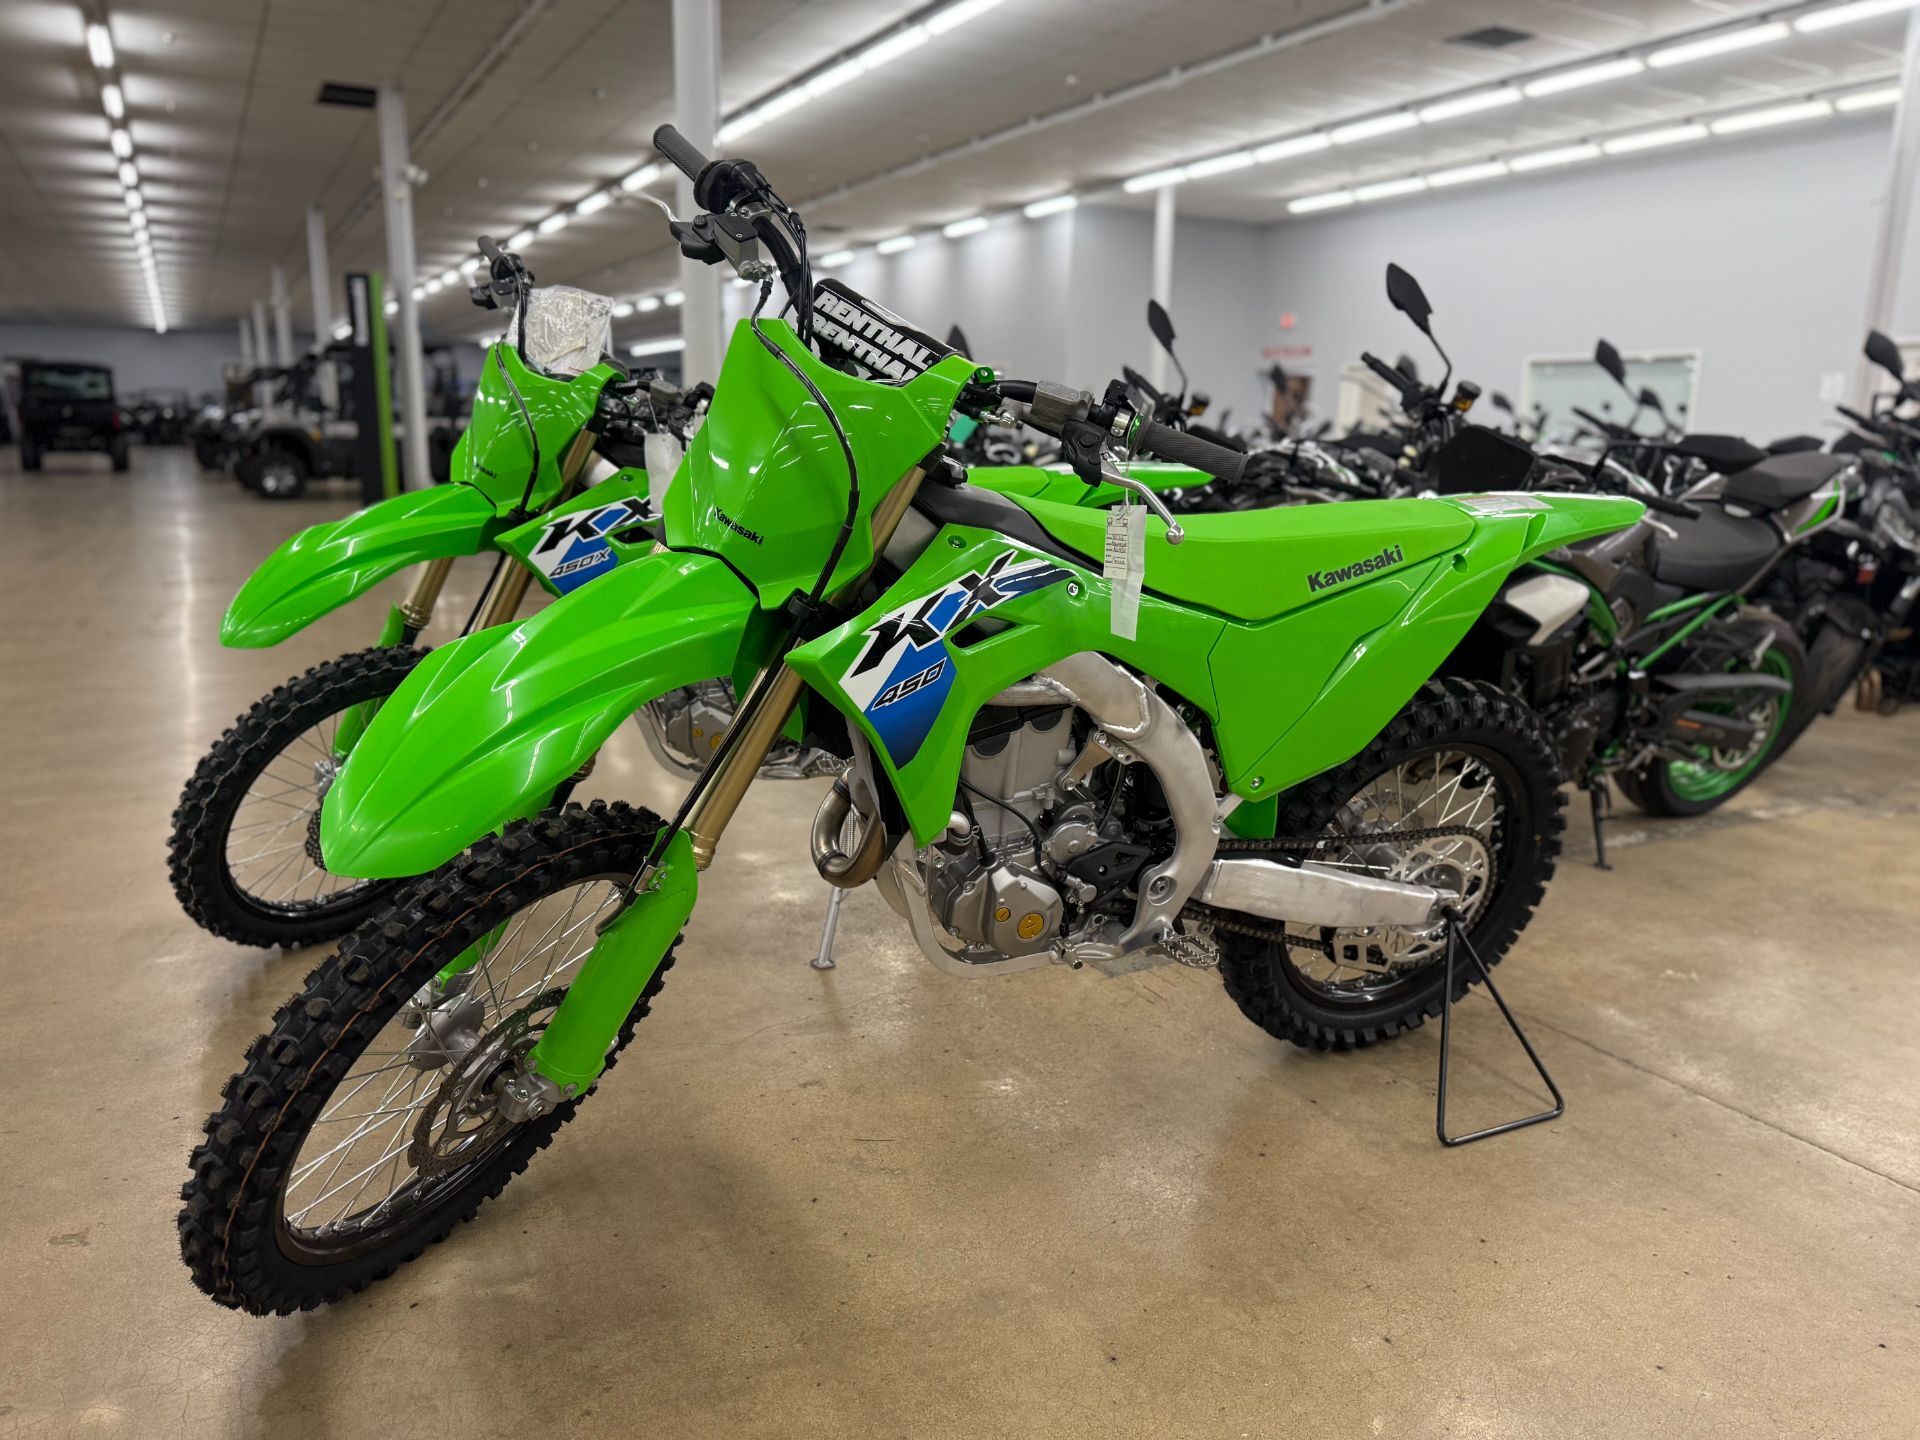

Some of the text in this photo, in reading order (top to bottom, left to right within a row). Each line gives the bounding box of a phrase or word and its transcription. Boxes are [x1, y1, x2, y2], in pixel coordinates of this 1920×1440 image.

[813, 290, 931, 371] RENTHAL
[714, 506, 765, 545] Kawasaki
[1307, 544, 1403, 592] Kawasaki
[850, 549, 1018, 679] KX
[871, 657, 948, 711] 450
